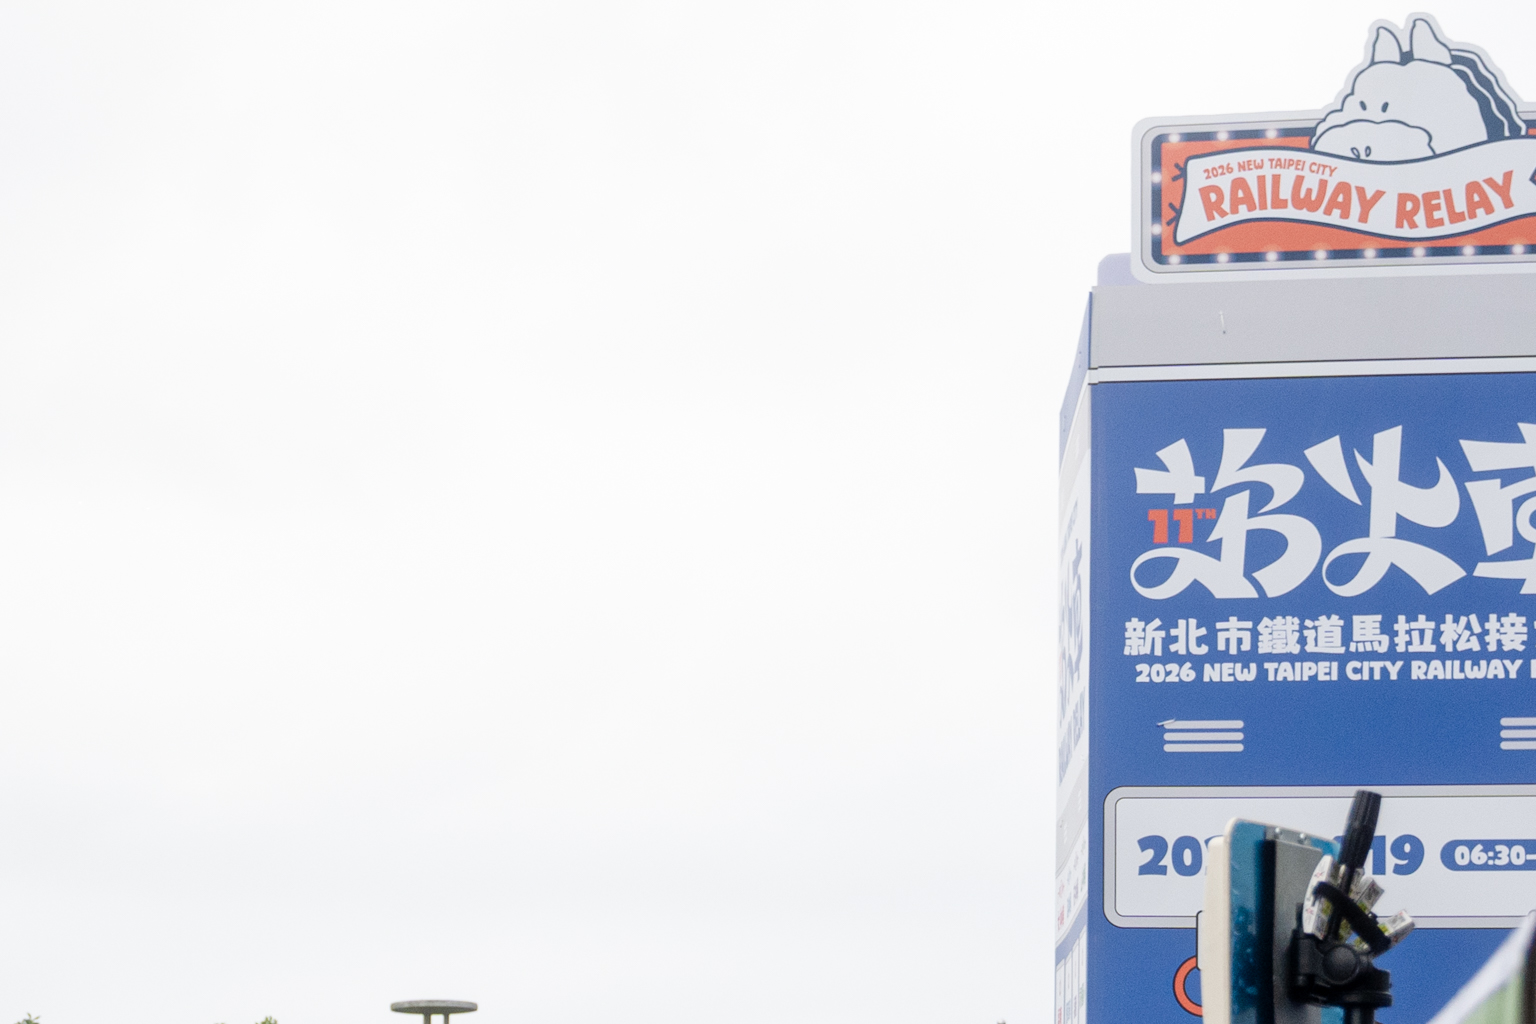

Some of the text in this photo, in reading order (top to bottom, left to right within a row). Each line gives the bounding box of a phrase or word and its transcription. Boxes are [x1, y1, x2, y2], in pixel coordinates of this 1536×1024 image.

[1203, 157, 1337, 180] 2026 NEW TAIPEI CITY
[1198, 169, 1514, 230] RAILWAY RELAY
[1147, 508, 1217, 544] 11TH
[1123, 611, 1536, 657] 新北市鐵道馬拉松接
[1135, 663, 1196, 683] 2026
[1203, 663, 1257, 683] NEW
[1264, 661, 1338, 682] TAIPEI
[1346, 660, 1404, 681] CITY
[1410, 659, 1523, 680] RAILWAY
